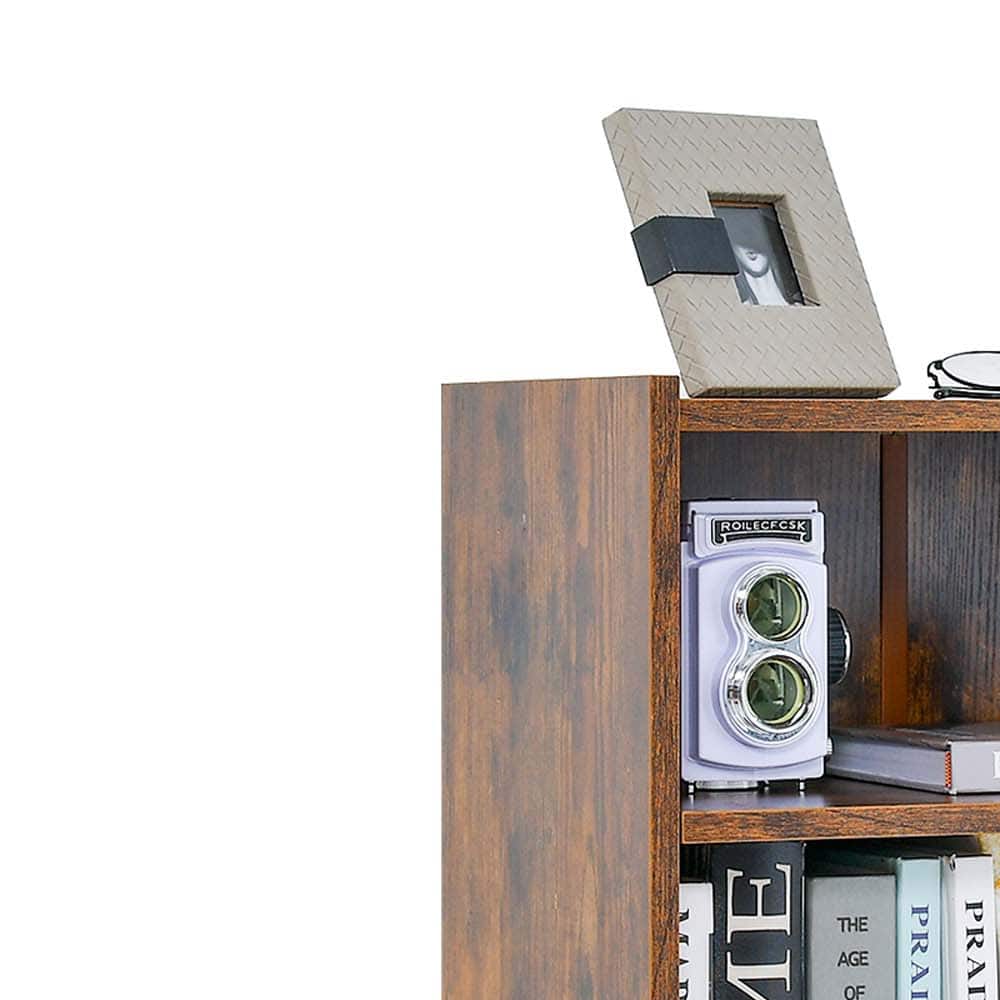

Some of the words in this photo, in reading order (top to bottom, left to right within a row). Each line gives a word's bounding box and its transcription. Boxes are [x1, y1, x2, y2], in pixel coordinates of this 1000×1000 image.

[836, 917, 869, 933] THE
[837, 951, 869, 967] AGE
[844, 985, 866, 1000] OF
